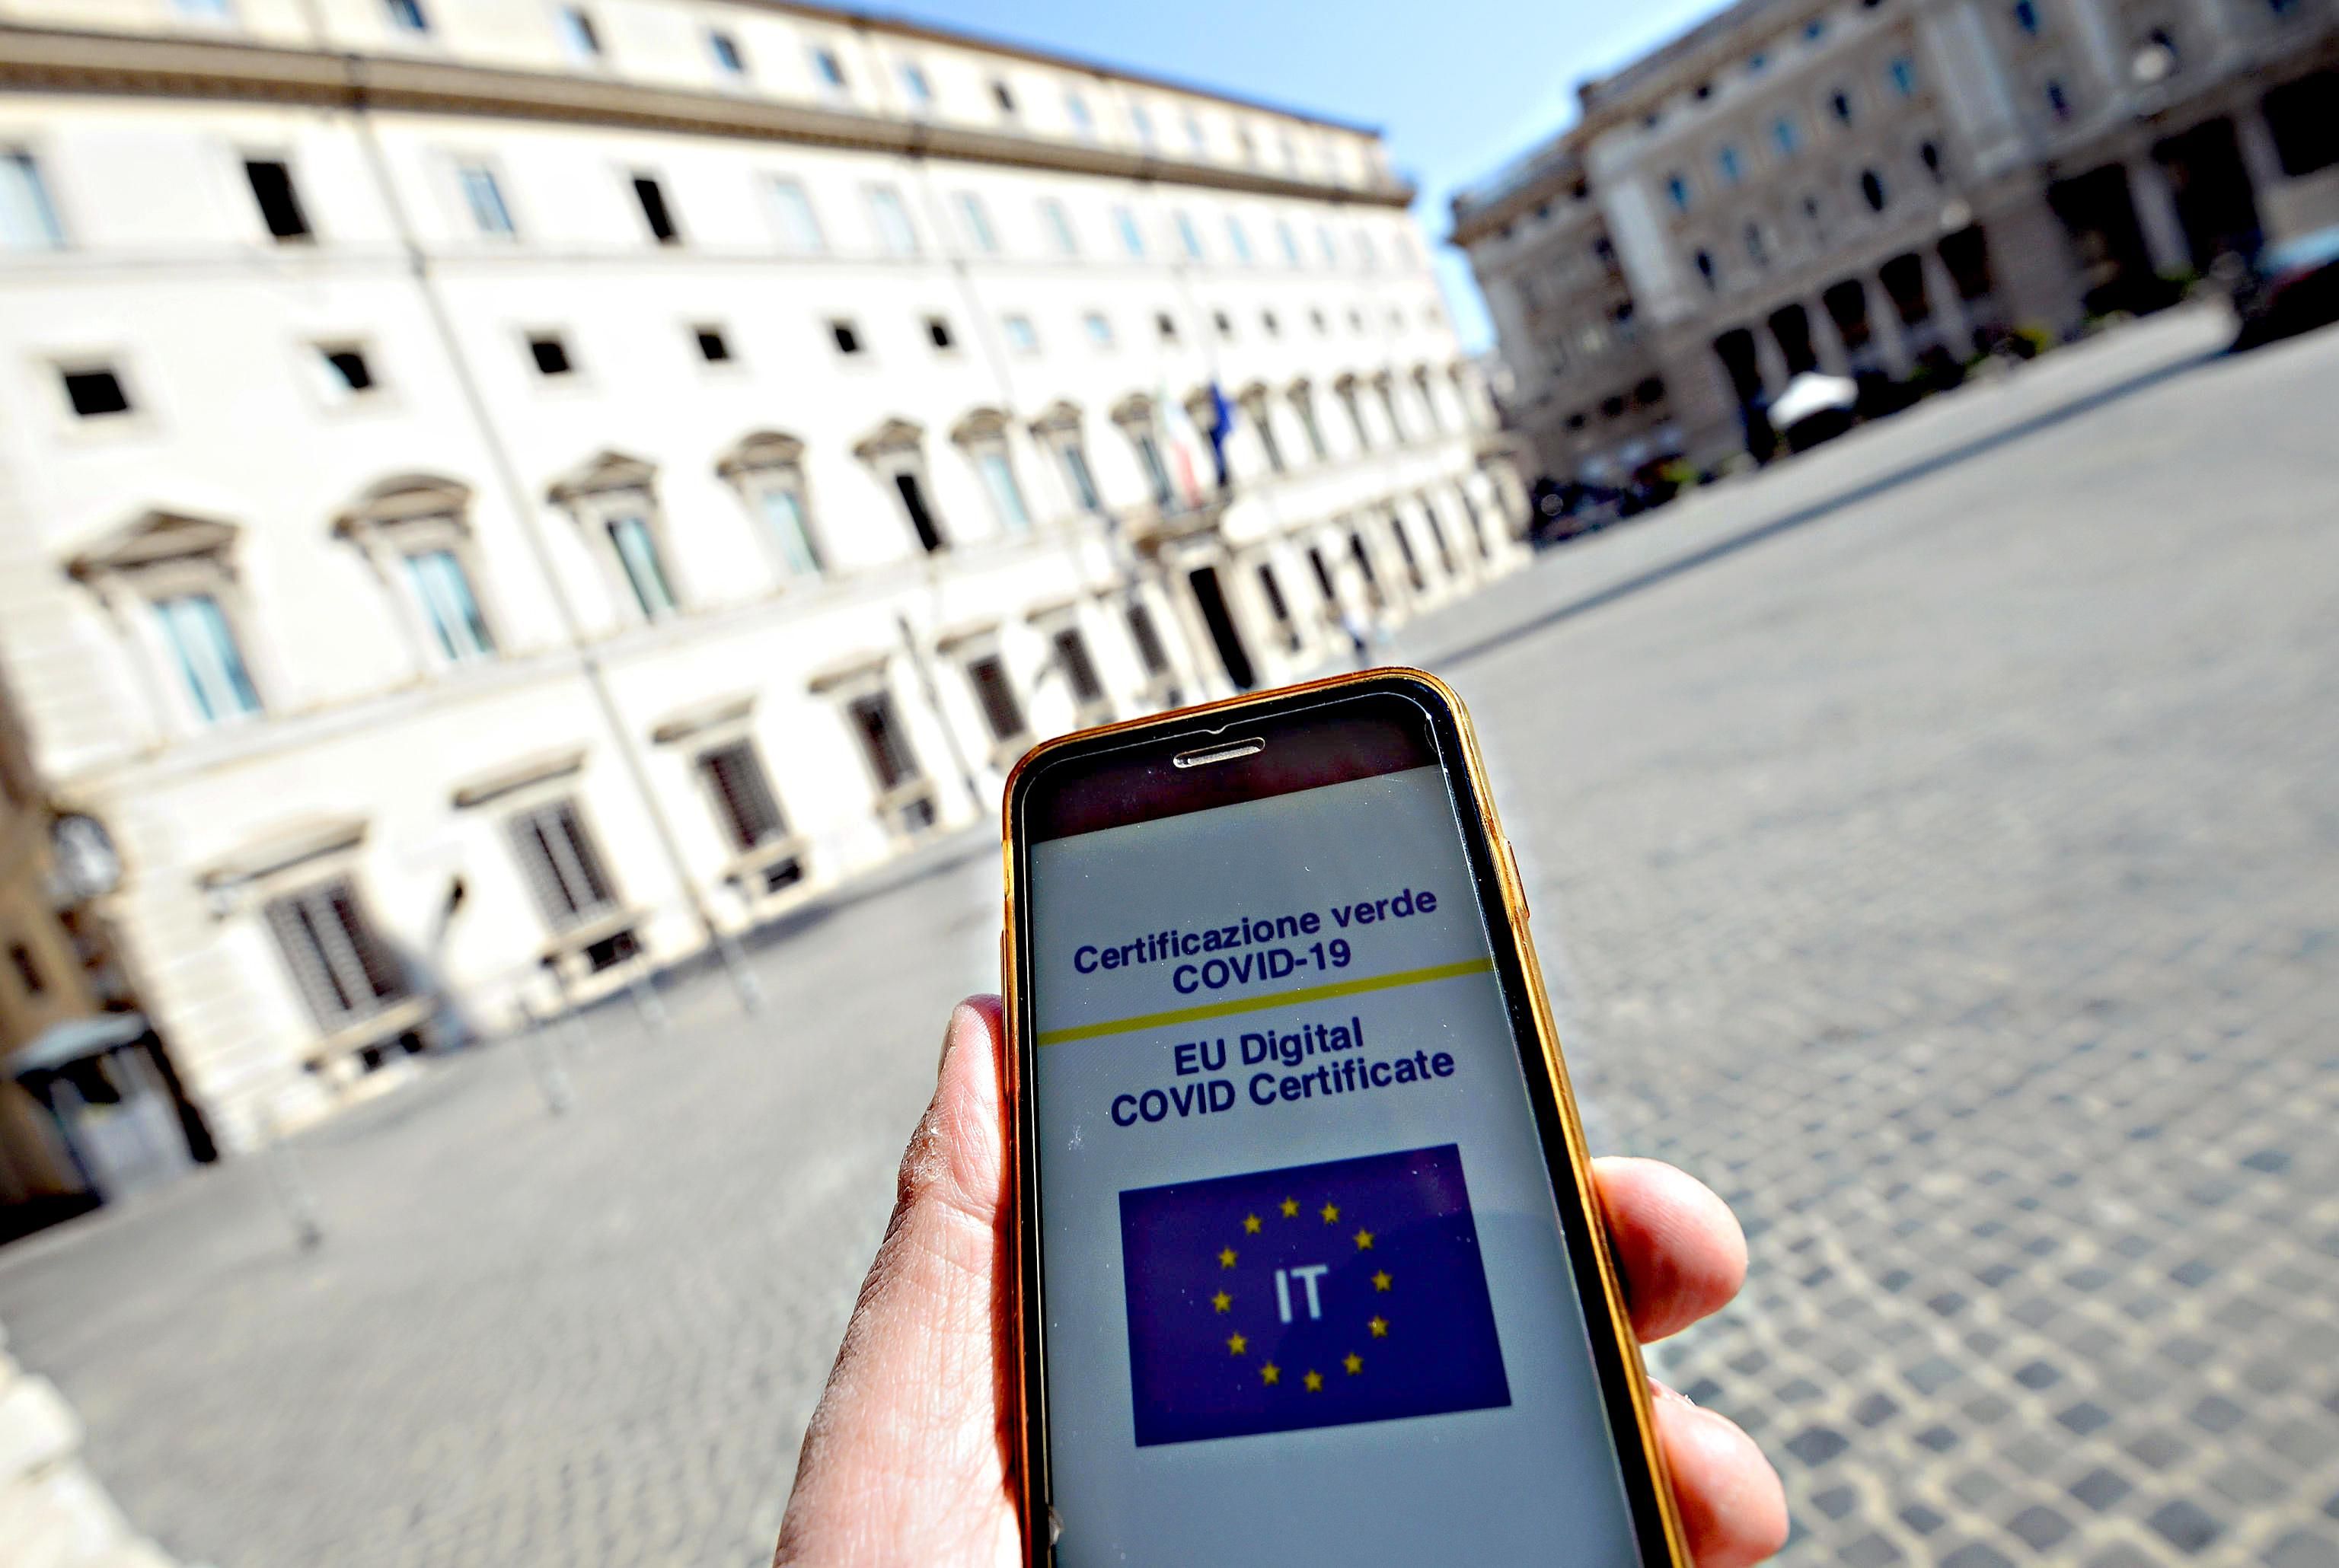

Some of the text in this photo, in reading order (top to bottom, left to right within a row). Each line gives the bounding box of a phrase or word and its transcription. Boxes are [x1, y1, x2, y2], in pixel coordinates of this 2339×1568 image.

[1074, 888, 1438, 974] Certificazione verde
[1173, 939, 1352, 994] COVID-19
[1174, 1017, 1364, 1076] EU Digital
[1111, 1050, 1454, 1127] COVID Certificate
[1275, 1264, 1329, 1323] IT
